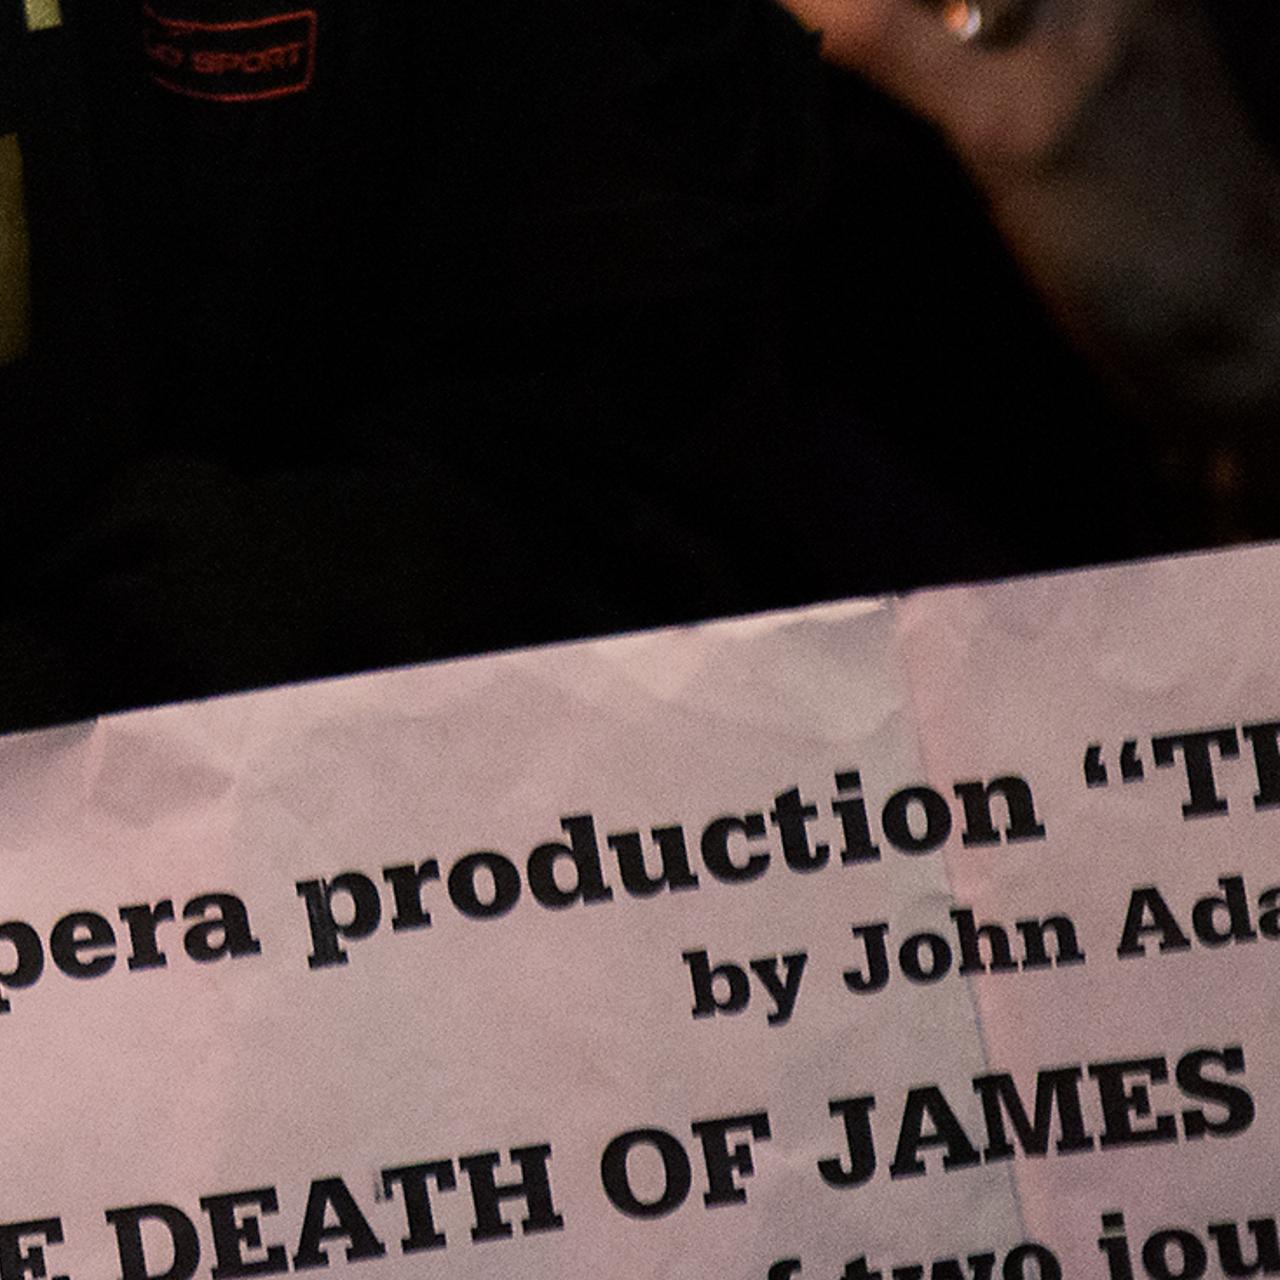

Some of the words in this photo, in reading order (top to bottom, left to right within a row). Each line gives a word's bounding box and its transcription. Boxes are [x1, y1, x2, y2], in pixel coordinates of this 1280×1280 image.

[296, 770, 1045, 970] production
[683, 949, 808, 1026] by
[844, 908, 1085, 995] John
[105, 1143, 564, 1280] DEATH
[600, 1110, 771, 1220] OF
[818, 1045, 1256, 1190] JAMES
